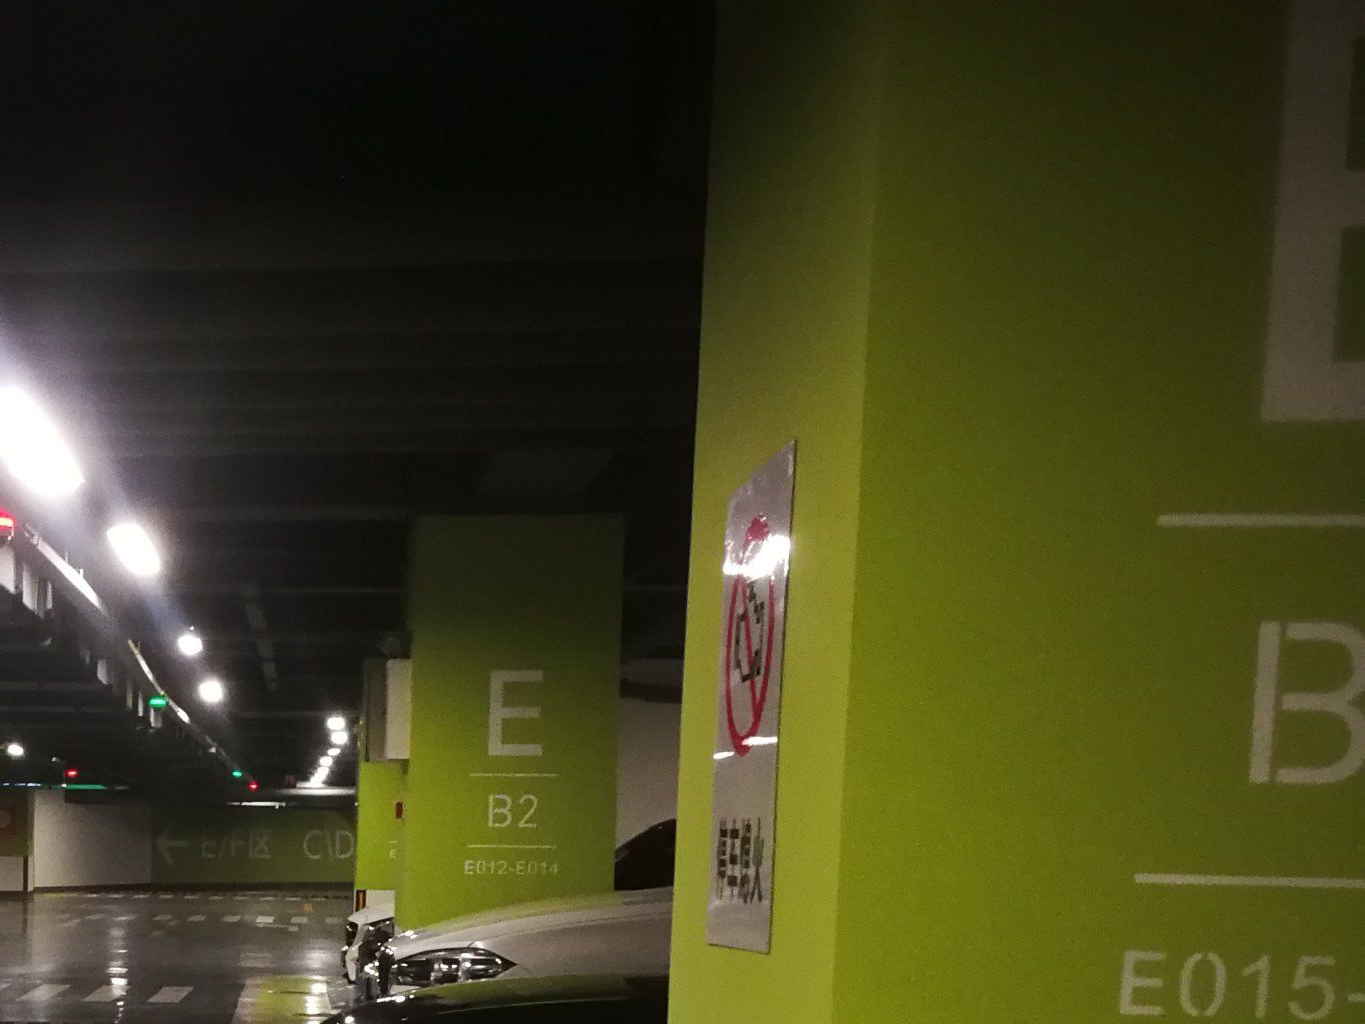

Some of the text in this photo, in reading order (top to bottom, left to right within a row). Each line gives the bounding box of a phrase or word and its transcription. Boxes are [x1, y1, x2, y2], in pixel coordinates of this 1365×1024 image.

[488, 670, 543, 756] E
[488, 793, 538, 828] B2
[464, 860, 559, 875] E012-E014
